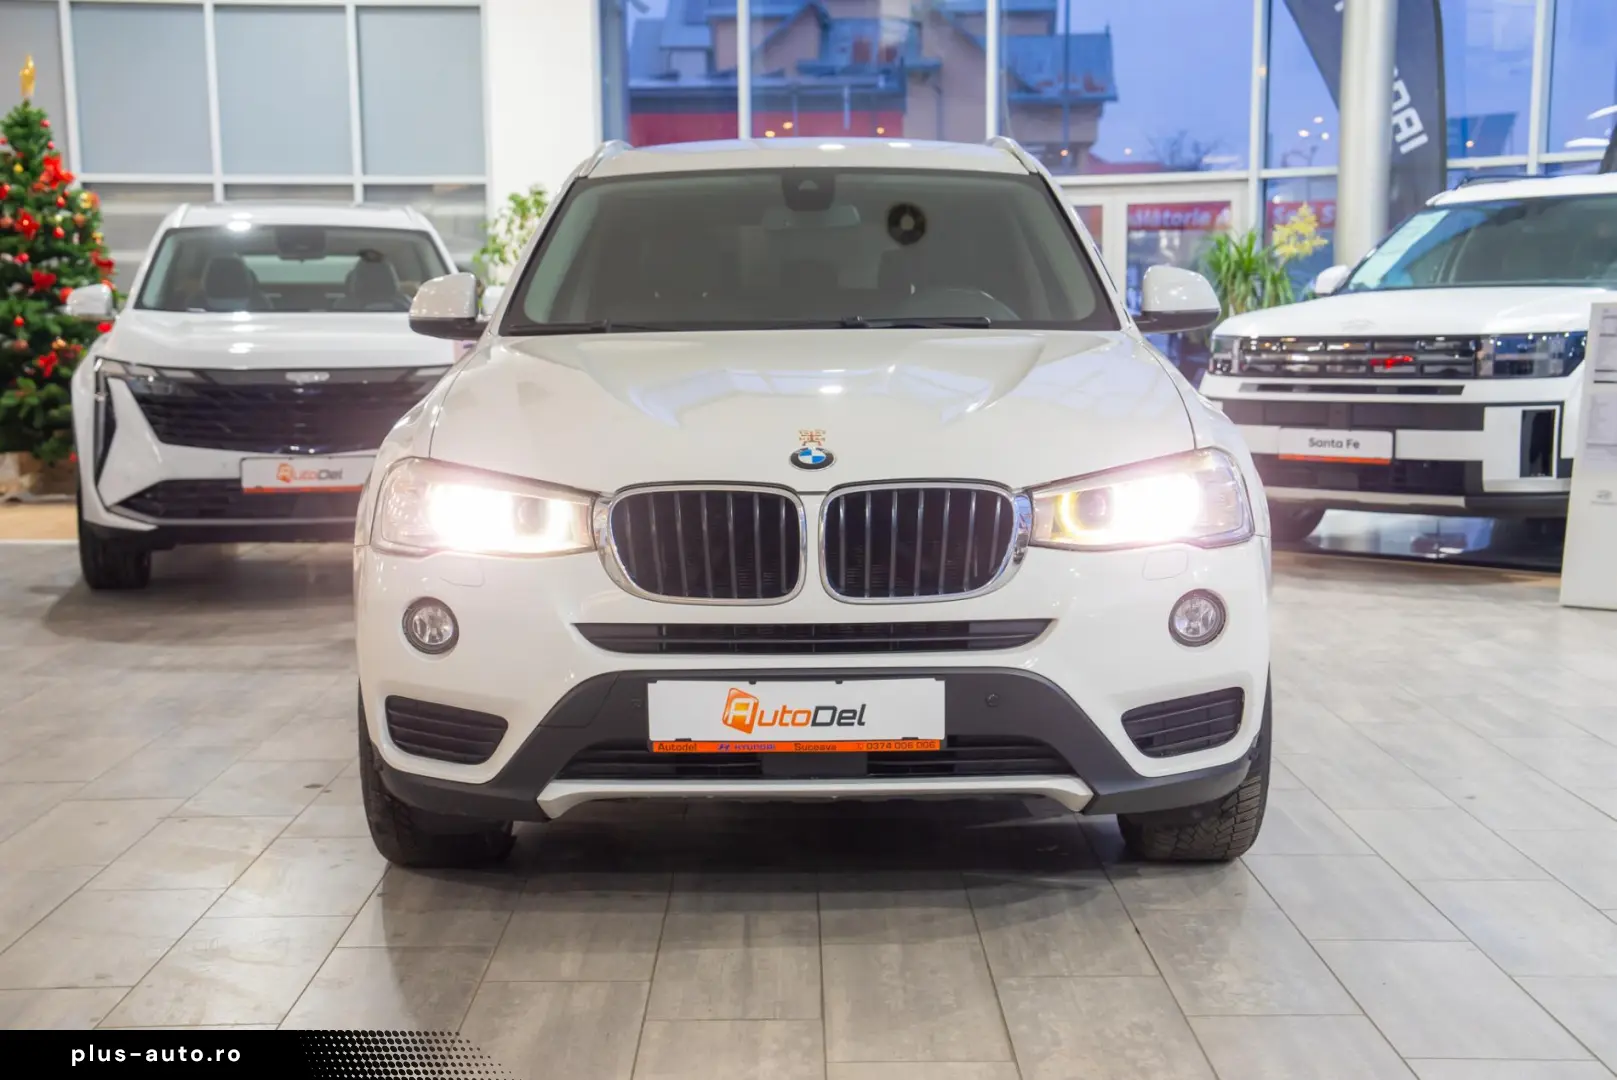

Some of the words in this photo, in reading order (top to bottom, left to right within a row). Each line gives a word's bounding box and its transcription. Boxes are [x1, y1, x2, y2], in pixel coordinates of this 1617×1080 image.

[1308, 437, 1343, 449] Santa
[1346, 438, 1360, 449] Fe
[722, 687, 867, 734] AutoDel
